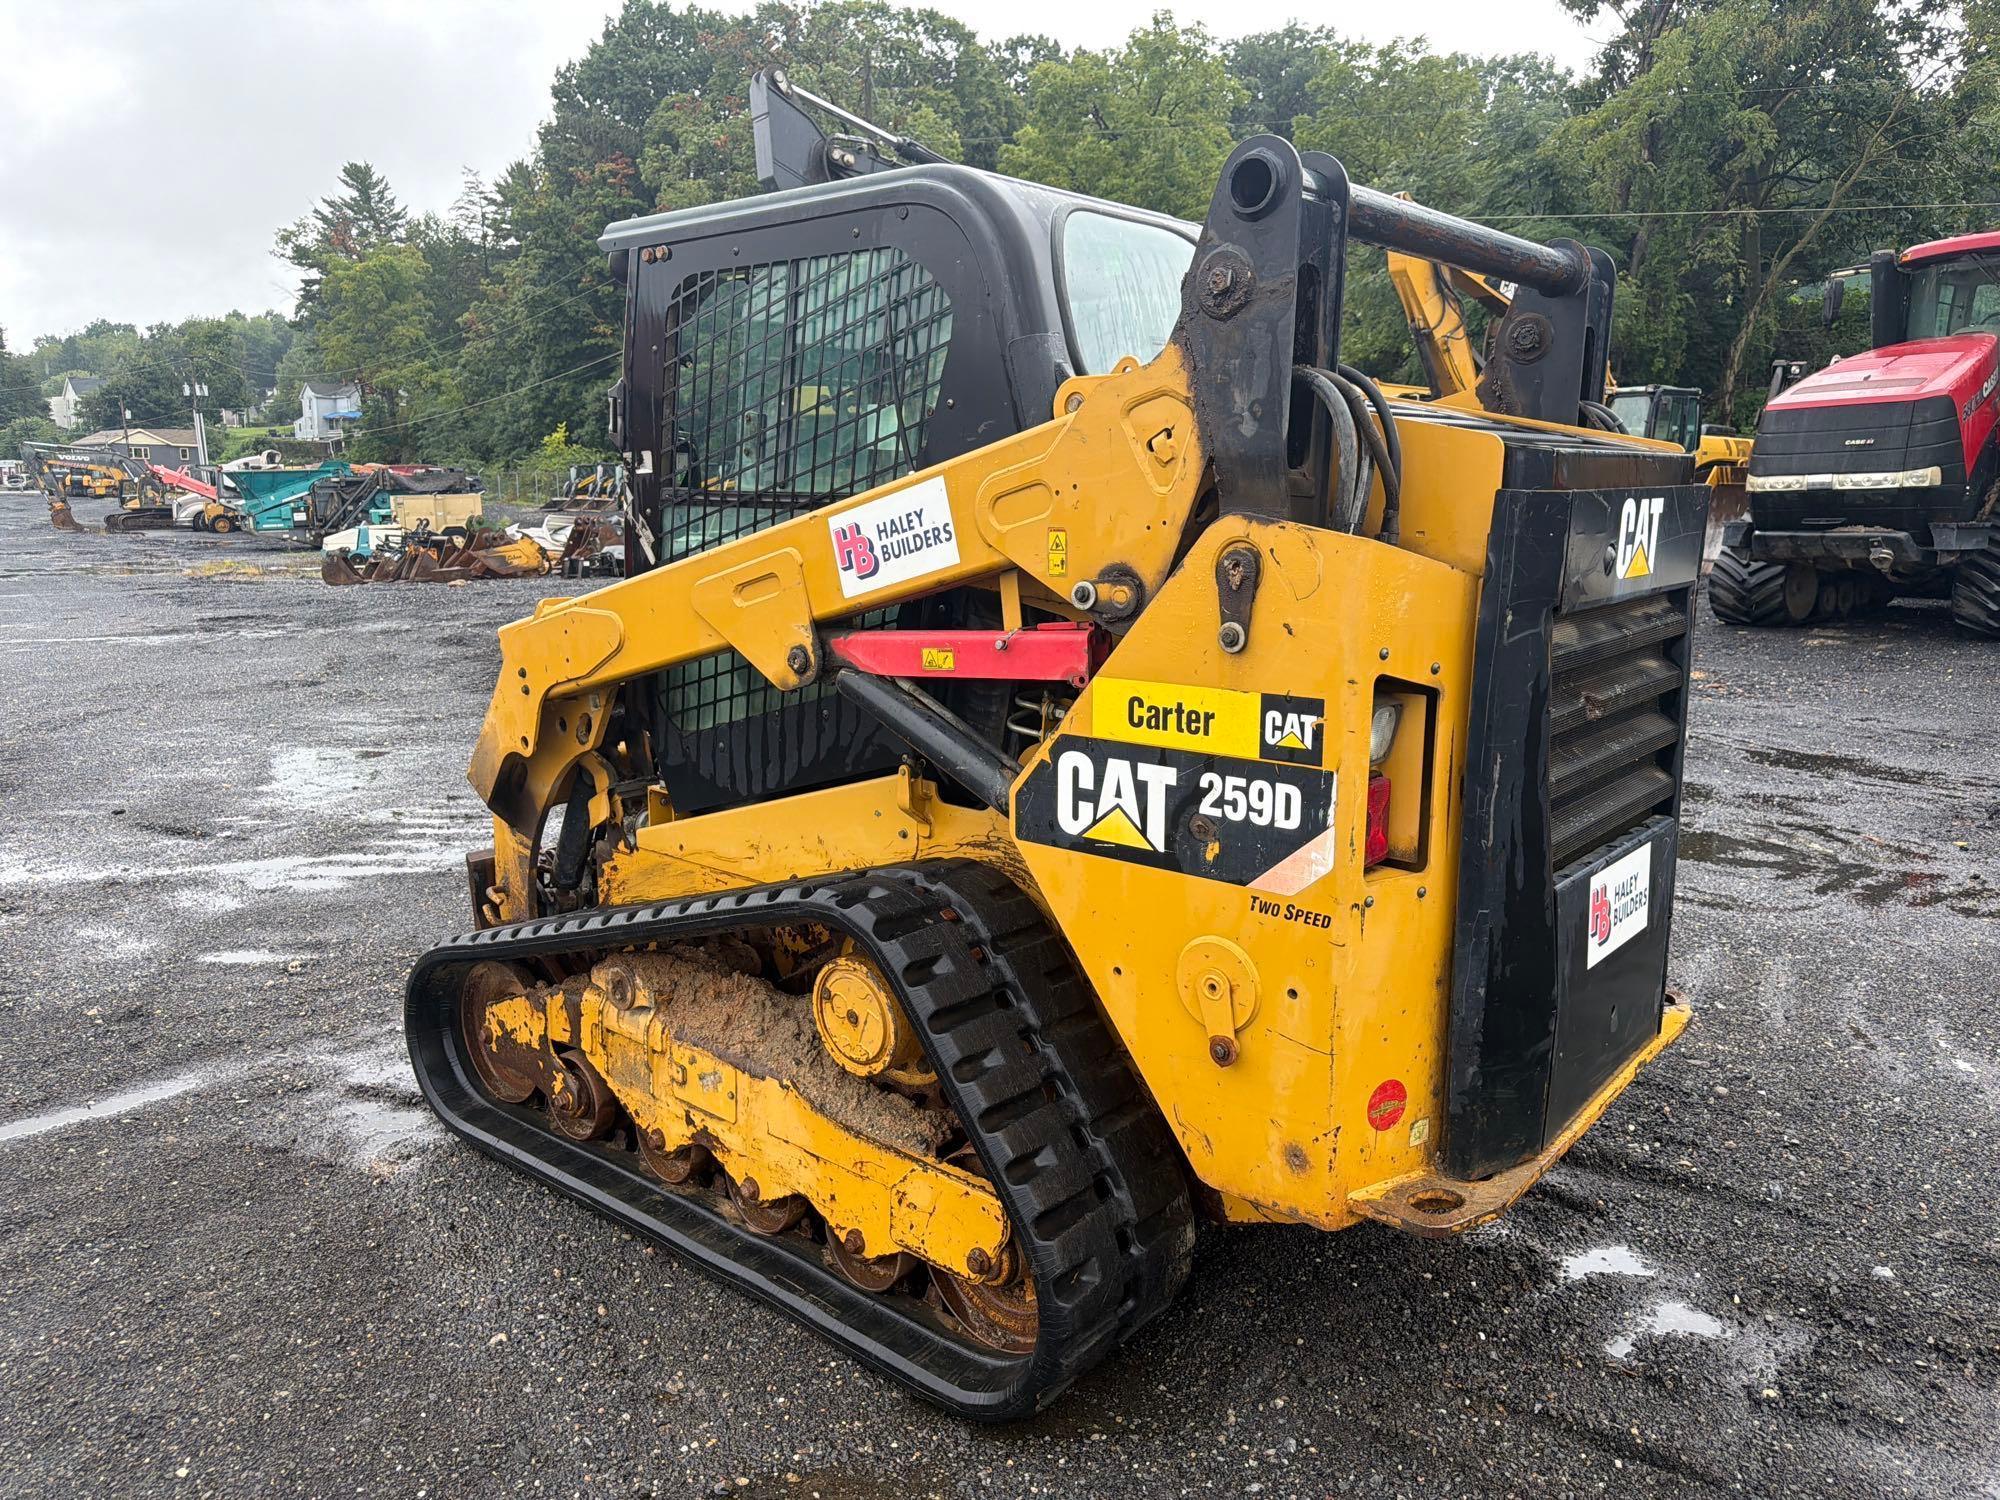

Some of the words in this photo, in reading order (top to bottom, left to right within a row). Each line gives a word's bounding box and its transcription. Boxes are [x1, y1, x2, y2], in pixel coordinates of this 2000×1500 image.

[57, 454, 90, 462] VOLVO
[875, 507, 924, 542] HALEY
[880, 521, 953, 563] BUILDERS
[1616, 497, 1664, 579] CAT
[833, 521, 880, 581] HB
[1127, 695, 1216, 737] Carter
[1264, 710, 1319, 750] CAT
[1057, 750, 1178, 853] CAT
[1198, 772, 1302, 830] 259D
[1613, 887, 1648, 927] BUILDERS
[1614, 872, 1639, 905] HALEY
